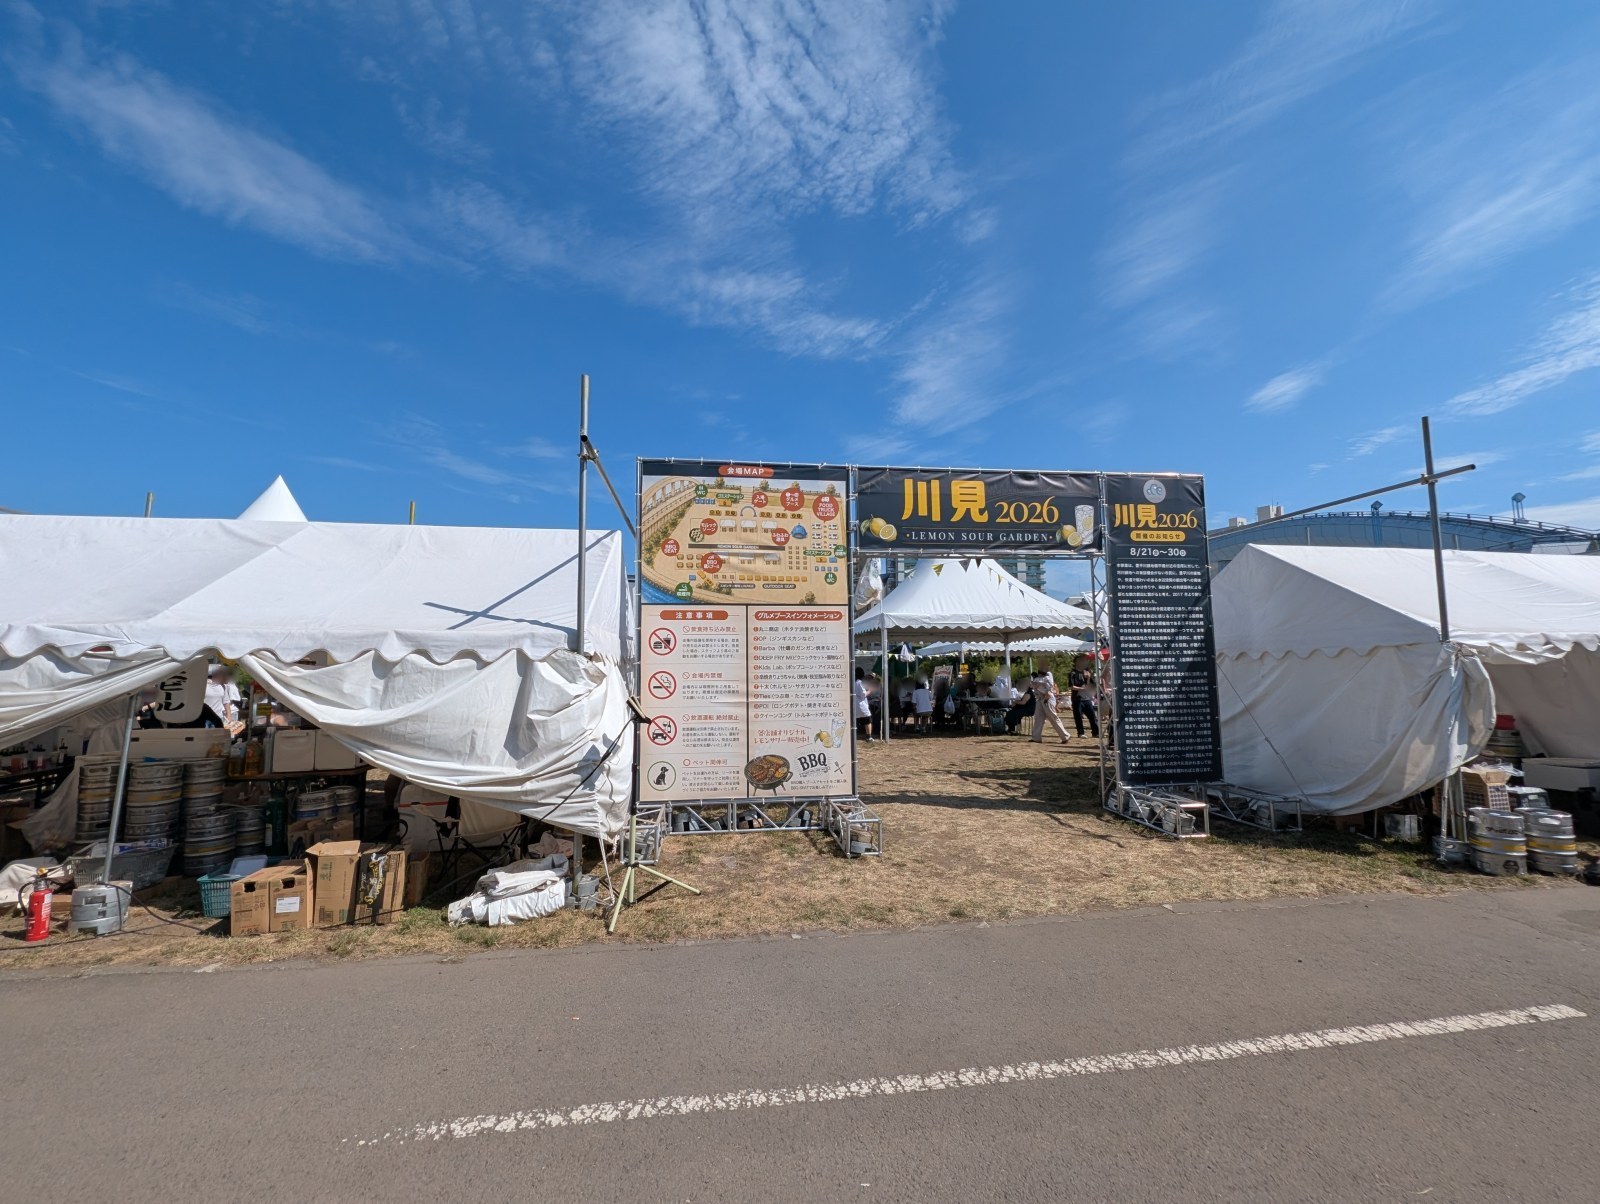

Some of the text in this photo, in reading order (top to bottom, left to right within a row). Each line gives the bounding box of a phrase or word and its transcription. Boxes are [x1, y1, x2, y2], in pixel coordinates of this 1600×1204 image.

[727, 466, 765, 475] 会場MAP
[901, 478, 1059, 524] 川見 2026
[1113, 503, 1198, 529] 川見 2026
[911, 531, 1048, 542] LEMON SOUR GARDEN
[797, 752, 828, 771] BBQ
